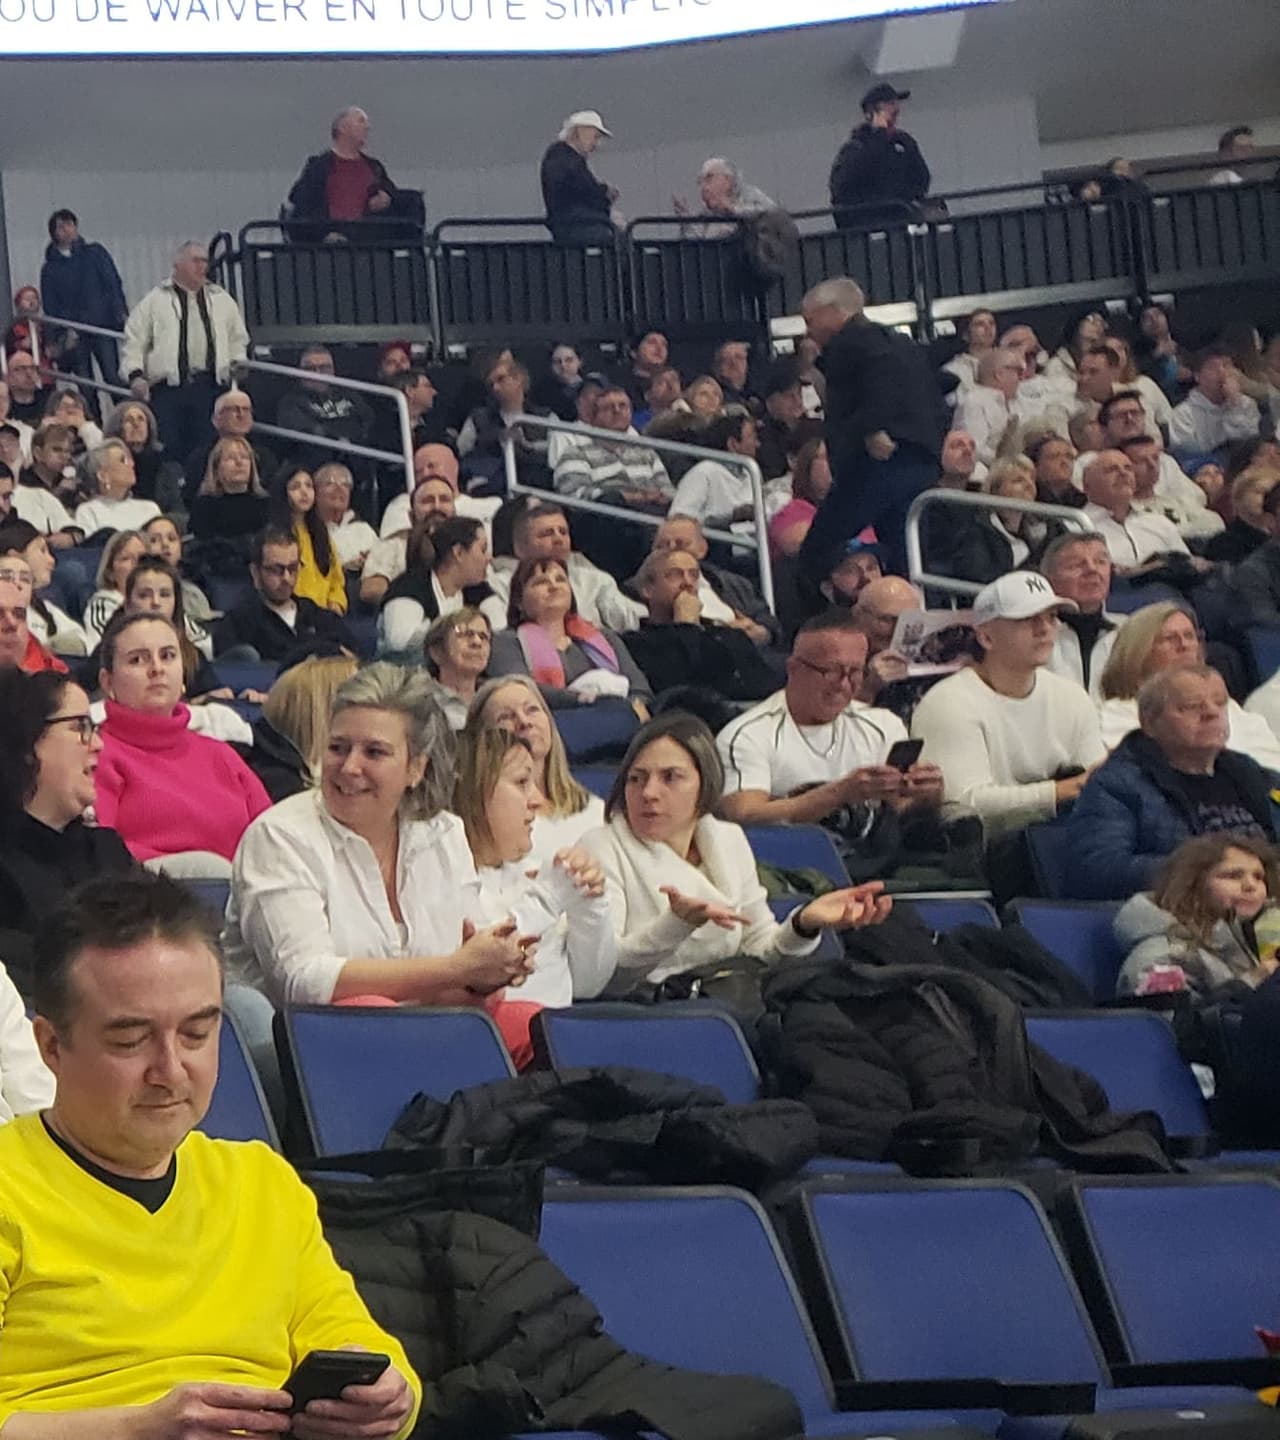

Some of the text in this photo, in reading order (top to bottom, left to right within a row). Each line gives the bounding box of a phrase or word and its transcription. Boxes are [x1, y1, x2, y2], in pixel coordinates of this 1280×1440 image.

[75, 0, 130, 21] DE
[145, 0, 308, 22] WAIVER
[324, 0, 376, 21] EN
